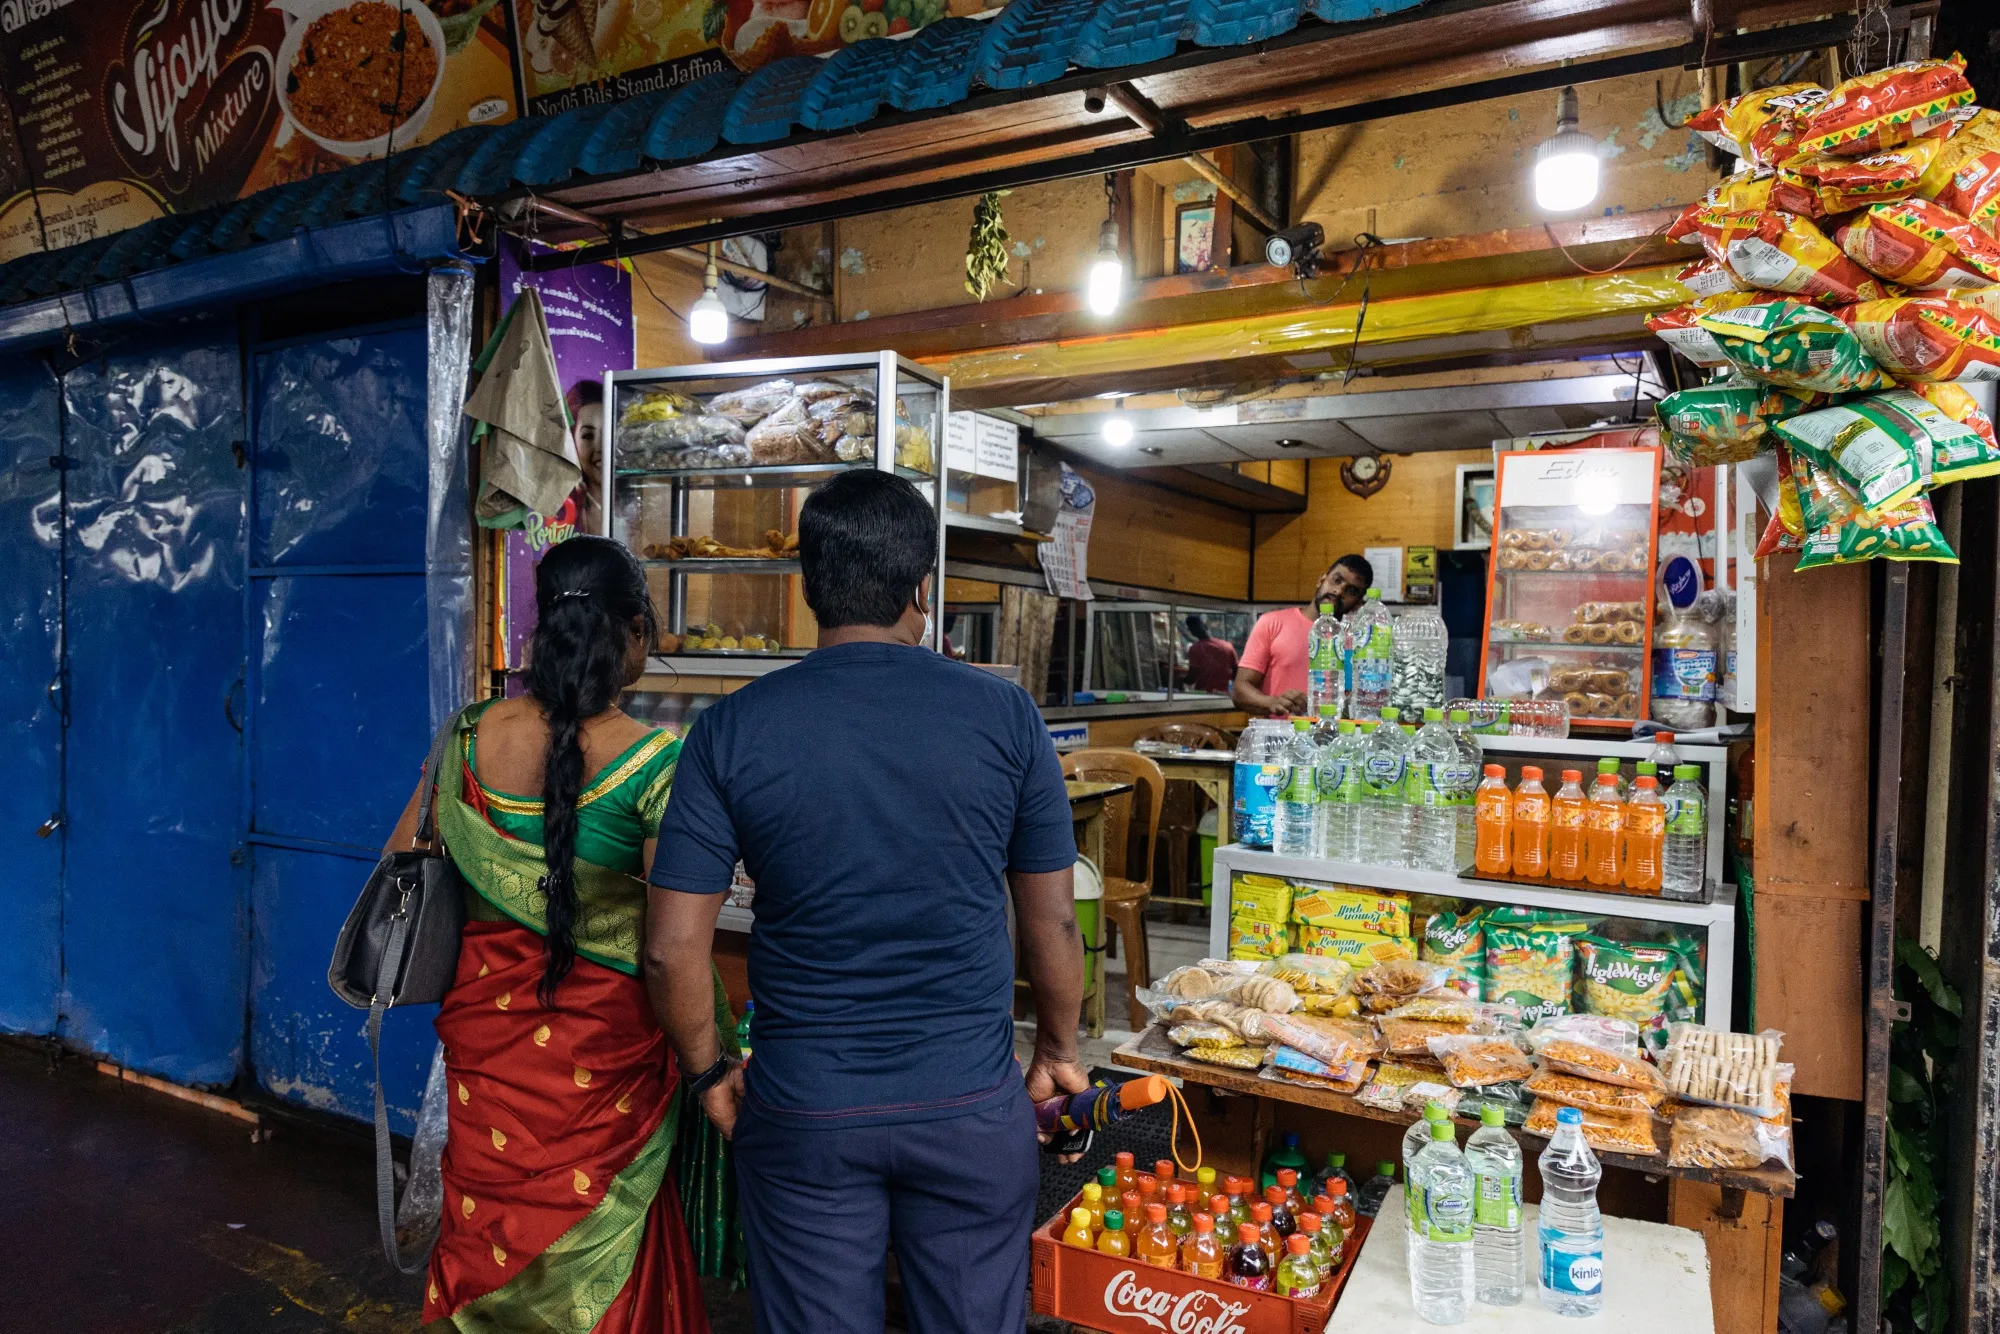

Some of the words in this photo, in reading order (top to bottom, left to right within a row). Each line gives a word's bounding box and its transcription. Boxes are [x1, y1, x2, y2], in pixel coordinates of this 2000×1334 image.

[194, 59, 265, 175] Mixture
[1860, 154, 1913, 166] Original
[1316, 936, 1356, 949] Lemon
[1337, 942, 1367, 956] puff
[1104, 1270, 1252, 1334] Coca-Cola
